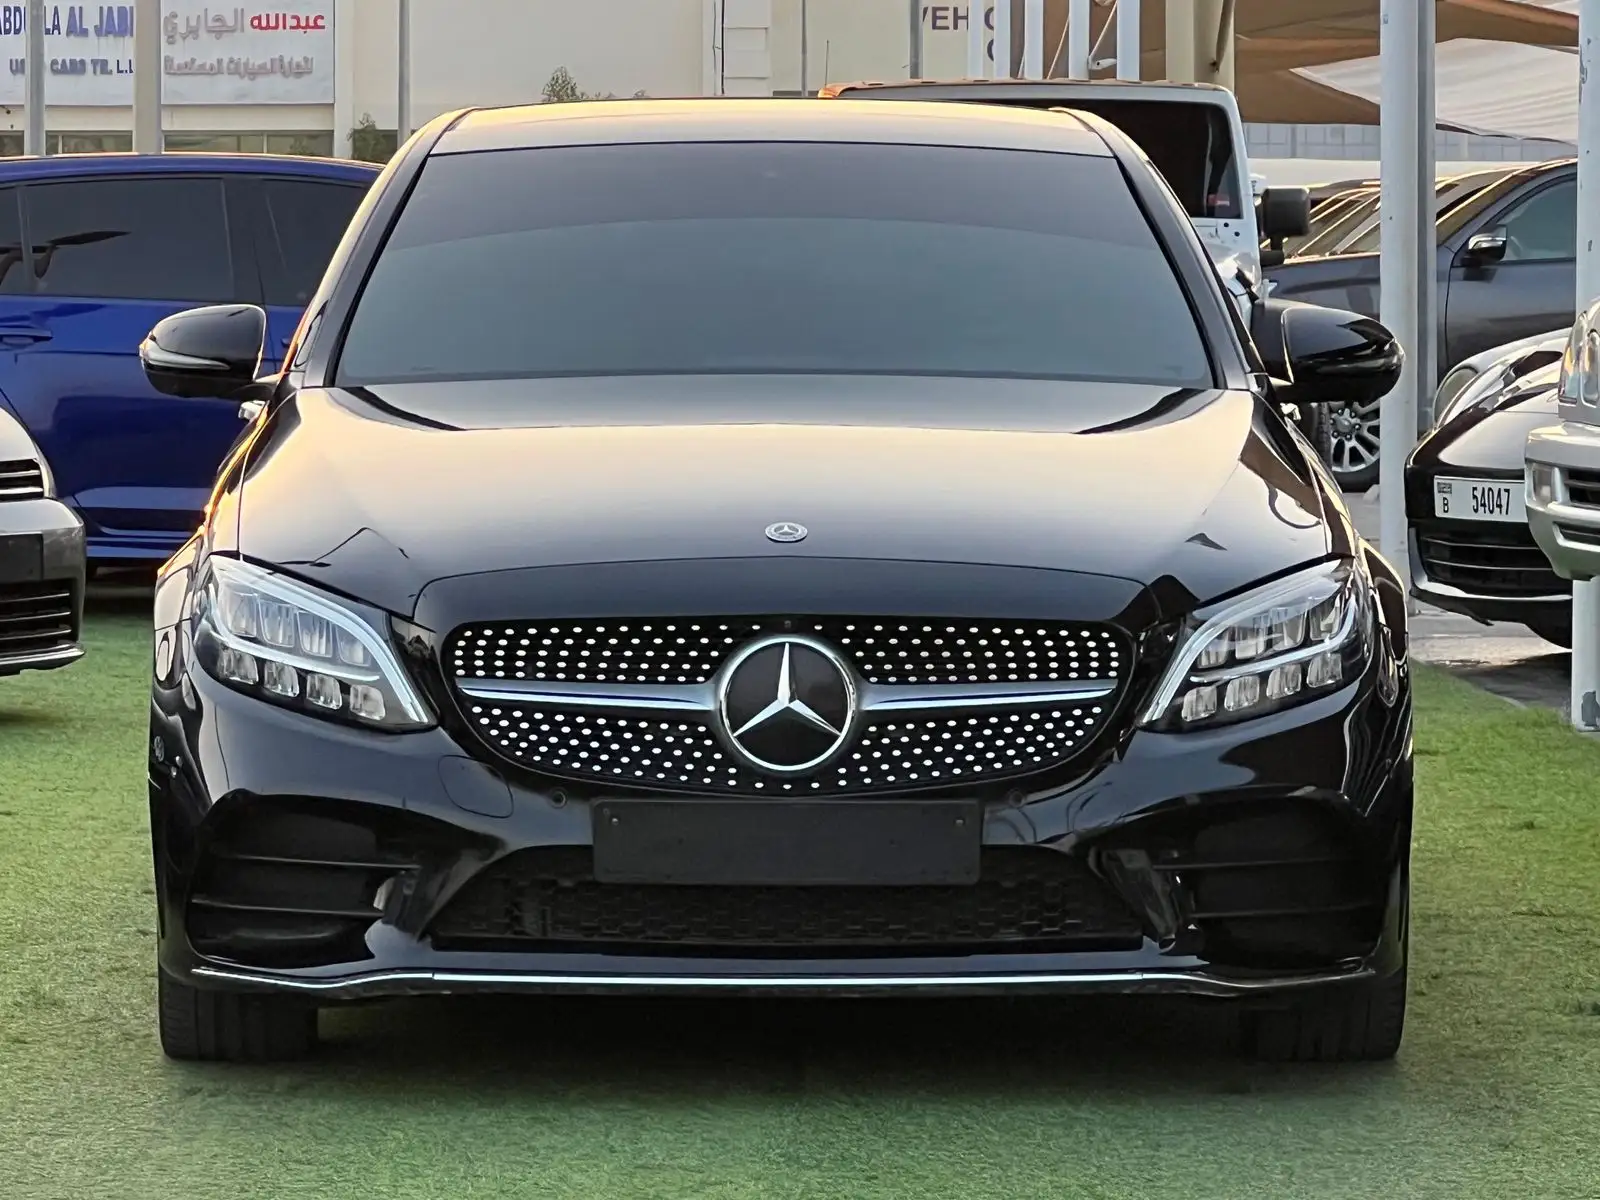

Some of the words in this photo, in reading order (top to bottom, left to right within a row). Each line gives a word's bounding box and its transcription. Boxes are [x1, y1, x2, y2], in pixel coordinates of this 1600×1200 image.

[66, 6, 88, 37] AL
[1443, 496, 1449, 513] B
[1472, 486, 1511, 516] 54047
